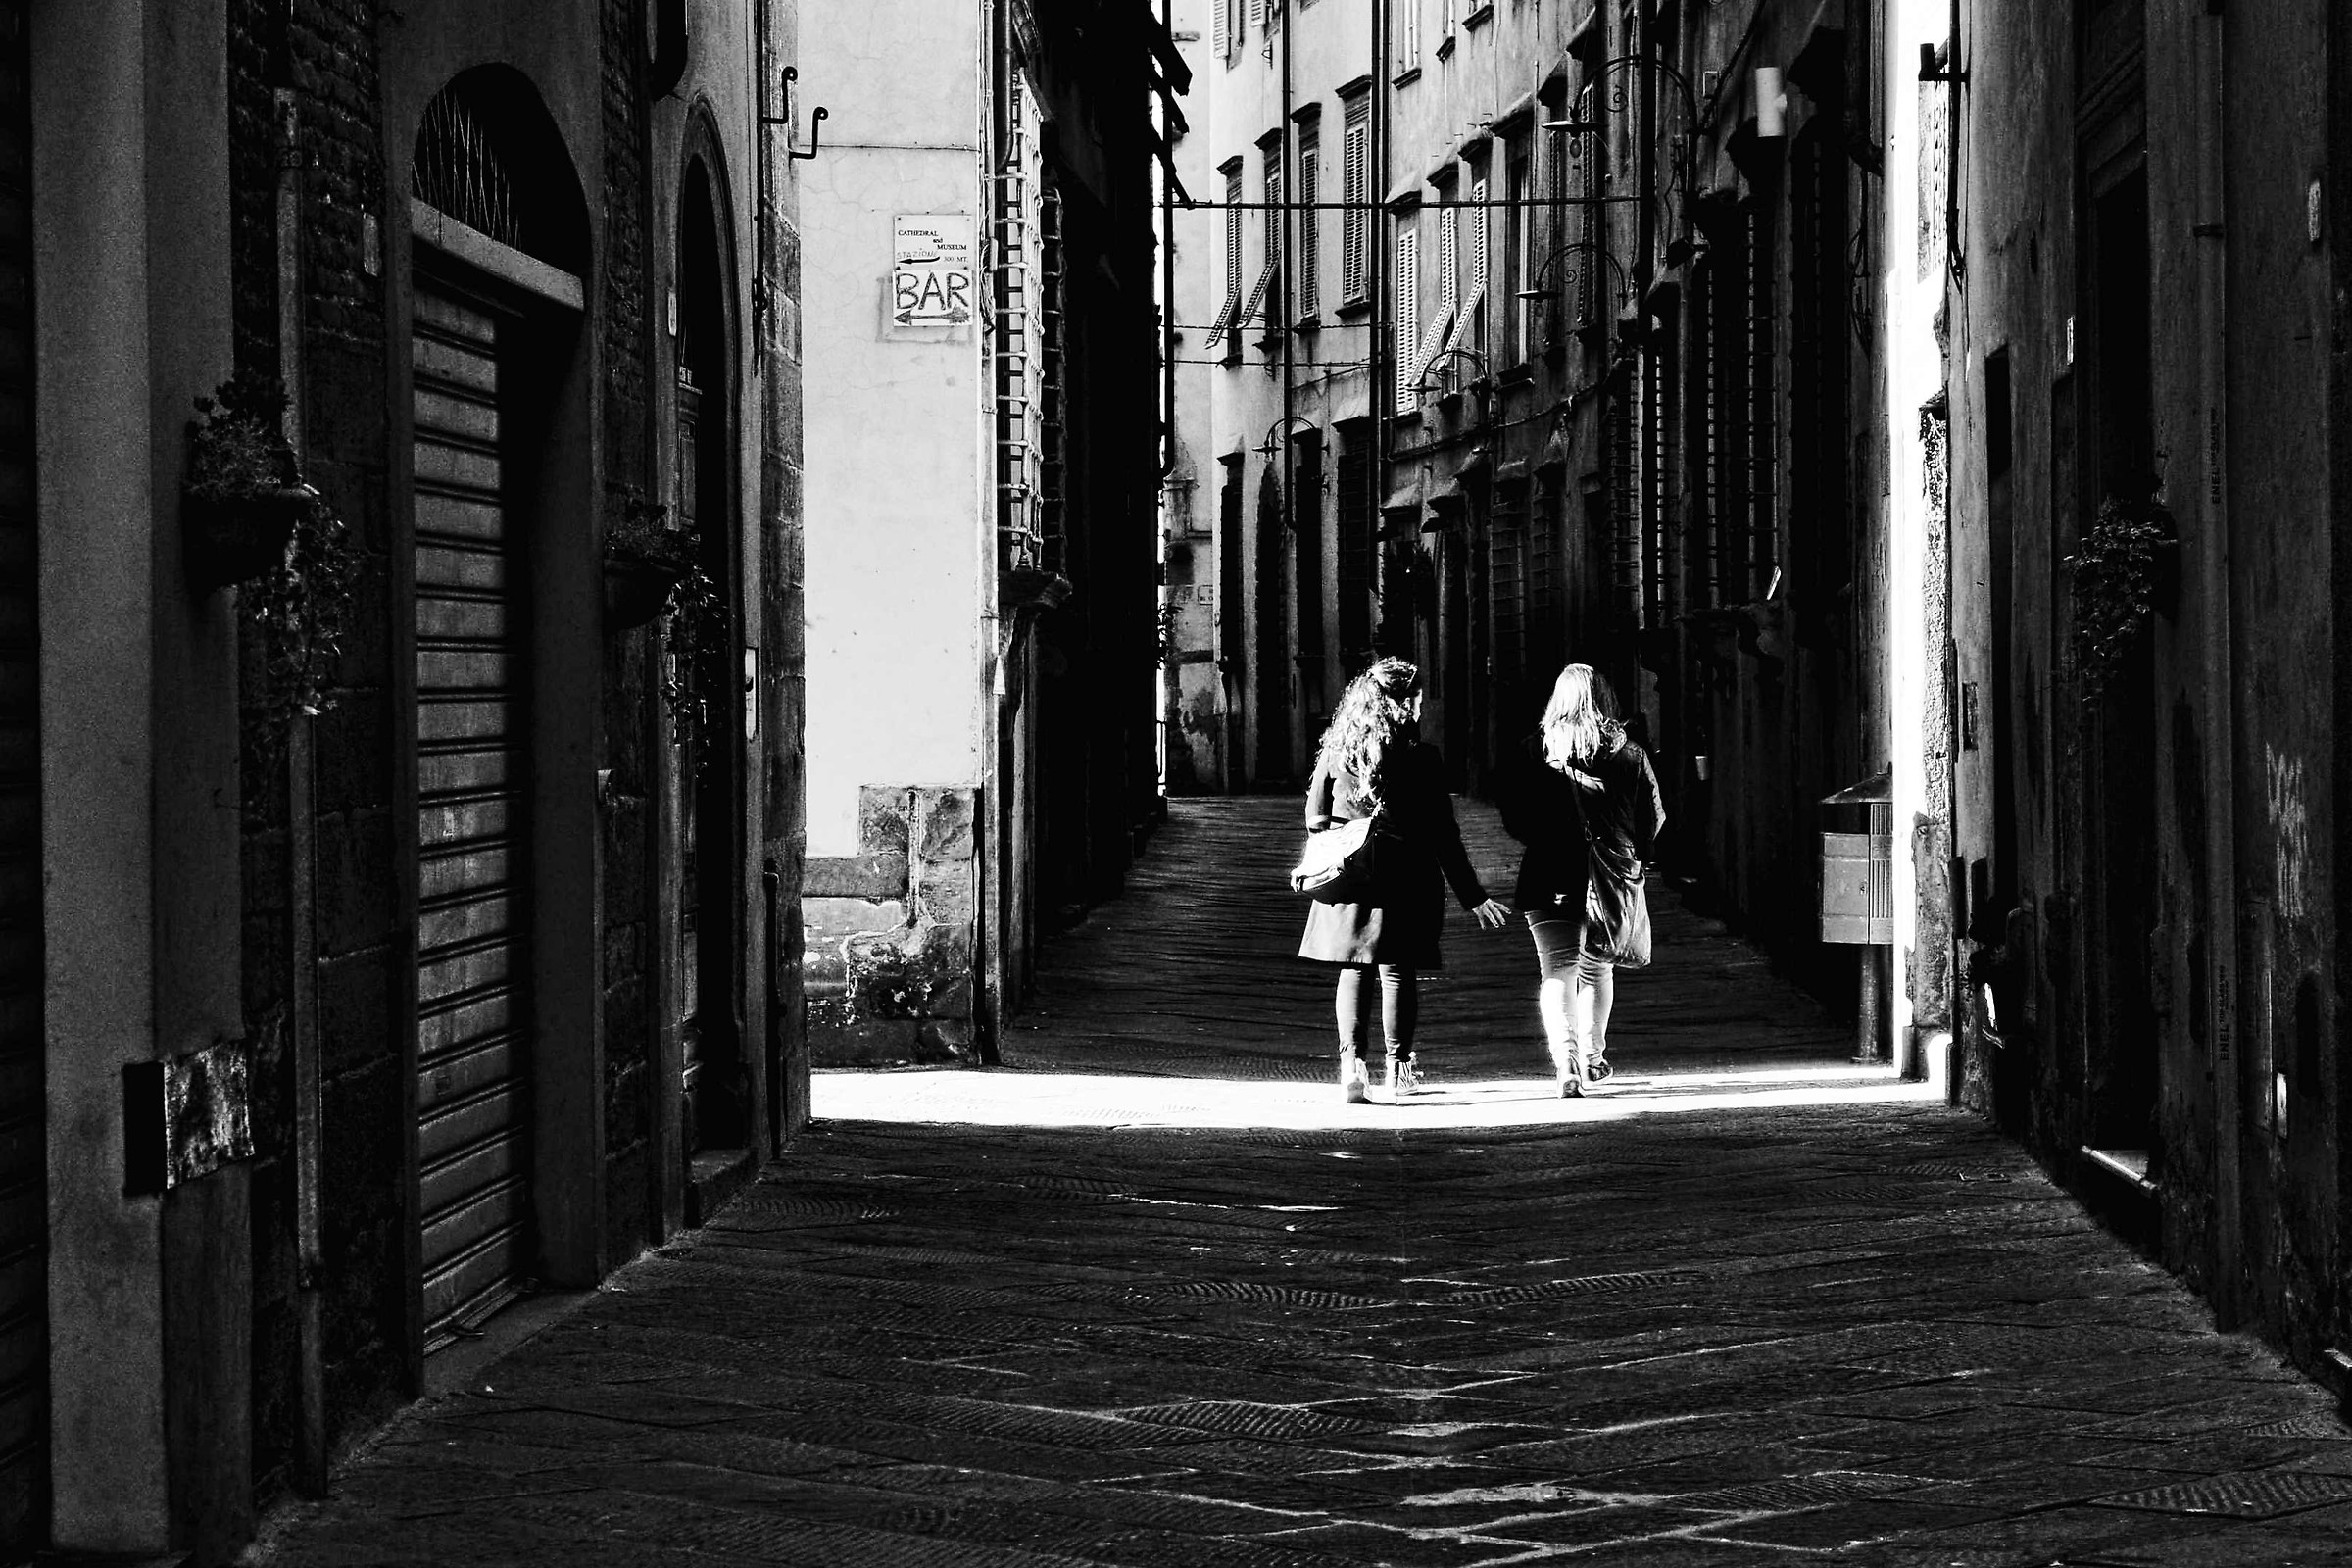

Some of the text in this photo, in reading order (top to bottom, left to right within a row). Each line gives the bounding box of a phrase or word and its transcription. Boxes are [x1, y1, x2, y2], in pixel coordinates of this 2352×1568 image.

[896, 272, 969, 310] BAR
[2211, 467, 2221, 505] ENEL
[2219, 1024, 2230, 1061] ENEL
